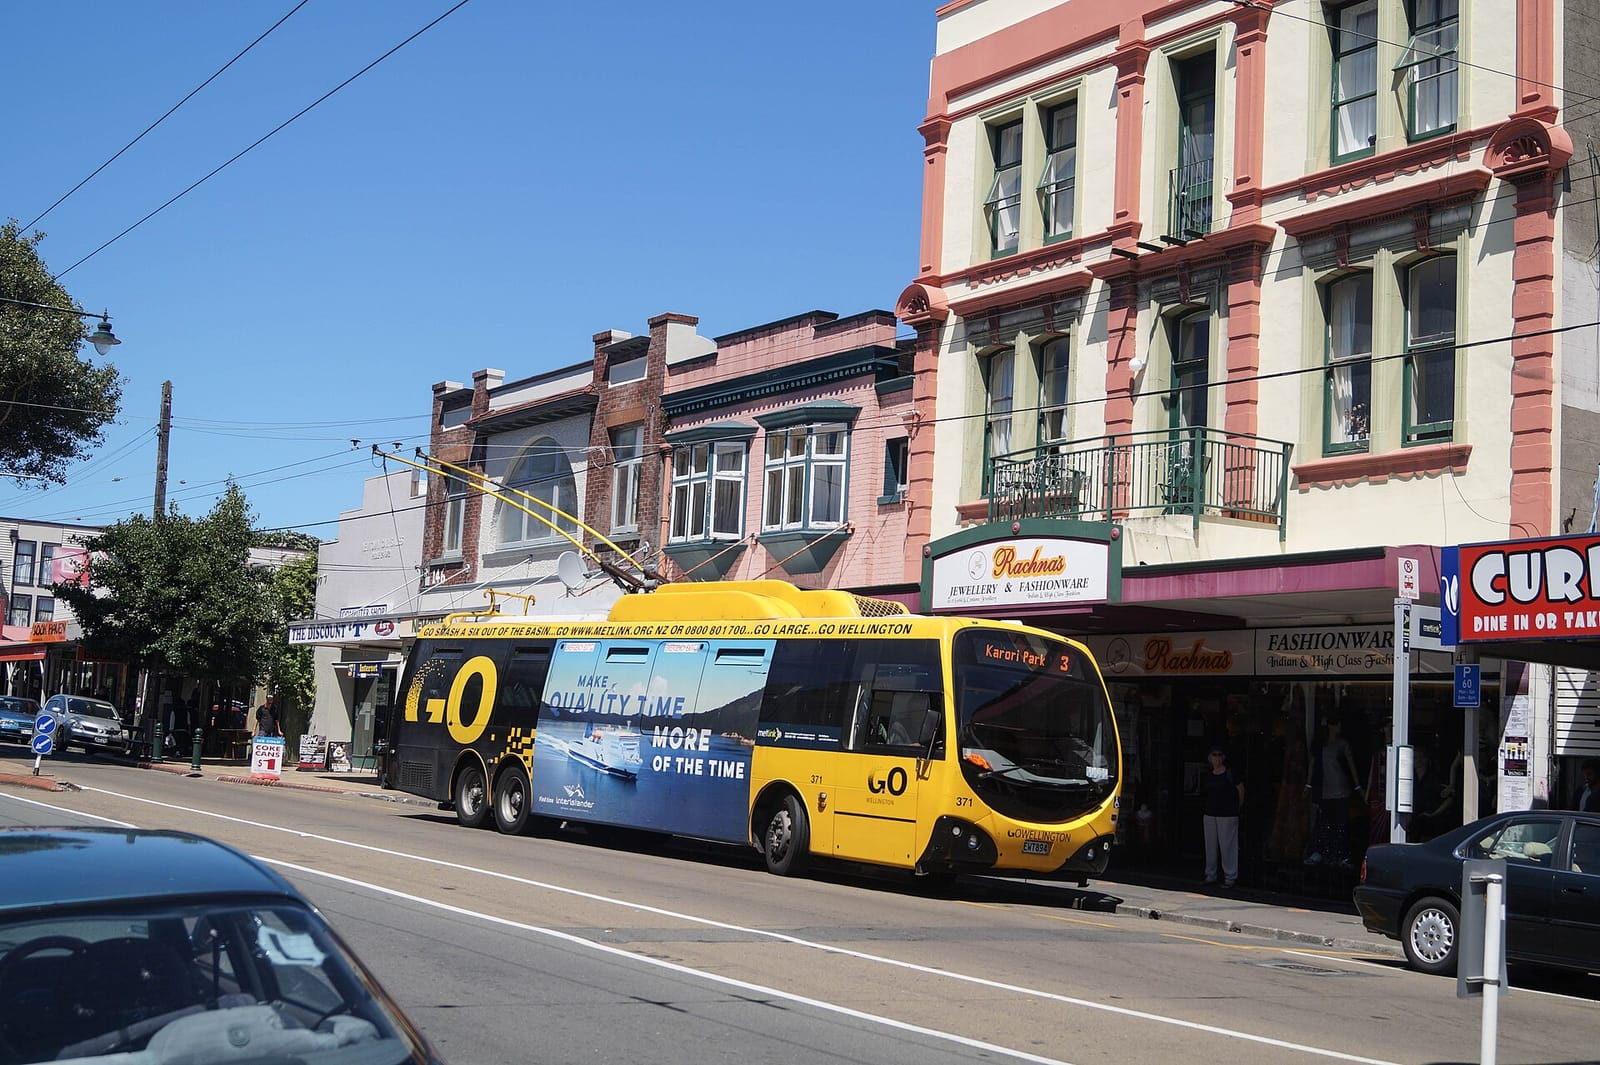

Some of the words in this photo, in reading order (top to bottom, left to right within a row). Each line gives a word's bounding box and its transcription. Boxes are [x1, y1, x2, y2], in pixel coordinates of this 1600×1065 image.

[993, 547, 1065, 577] Rachna's
[949, 583, 998, 597] JEWELLERY
[1004, 582, 1012, 593] &
[1019, 577, 1089, 592] FASHIONWARE
[424, 627, 434, 636] GO
[435, 627, 459, 636] SMASH
[461, 627, 466, 636] A
[468, 627, 480, 636] SIX
[481, 627, 497, 636] OUT
[498, 627, 508, 636] OF
[510, 626, 523, 636] THE
[571, 625, 653, 636] WWW.METLINK.ORG
[655, 625, 667, 635] NZ
[670, 625, 684, 635] OR
[685, 625, 709, 635] 0800
[838, 623, 912, 635] WELLINGTON
[1473, 615, 1507, 633] DINE
[1514, 614, 1529, 631] IN
[1535, 612, 1557, 630] OR
[1564, 611, 1600, 629] TAK
[291, 627, 306, 640] THE
[307, 624, 346, 640] DISCOUNT
[1267, 631, 1394, 651] FASHIONWAR
[985, 644, 1020, 662] Karori
[1022, 650, 1046, 667] Park
[1059, 655, 1070, 672] 3
[1267, 656, 1297, 668] Indian
[1300, 655, 1308, 668] &
[1309, 654, 1334, 670] High
[1336, 655, 1362, 668] Class
[577, 675, 609, 688] MAKE
[1463, 667, 1472, 678] P
[1462, 679, 1473, 688] 60
[550, 691, 630, 717] QUALITY
[652, 725, 712, 751] MORE
[255, 744, 281, 752] COKE
[652, 755, 672, 772] OF
[676, 757, 703, 776] THE
[709, 759, 745, 779] TIME
[810, 774, 823, 784] 371
[867, 765, 908, 796] GO
[956, 797, 973, 807] 371
